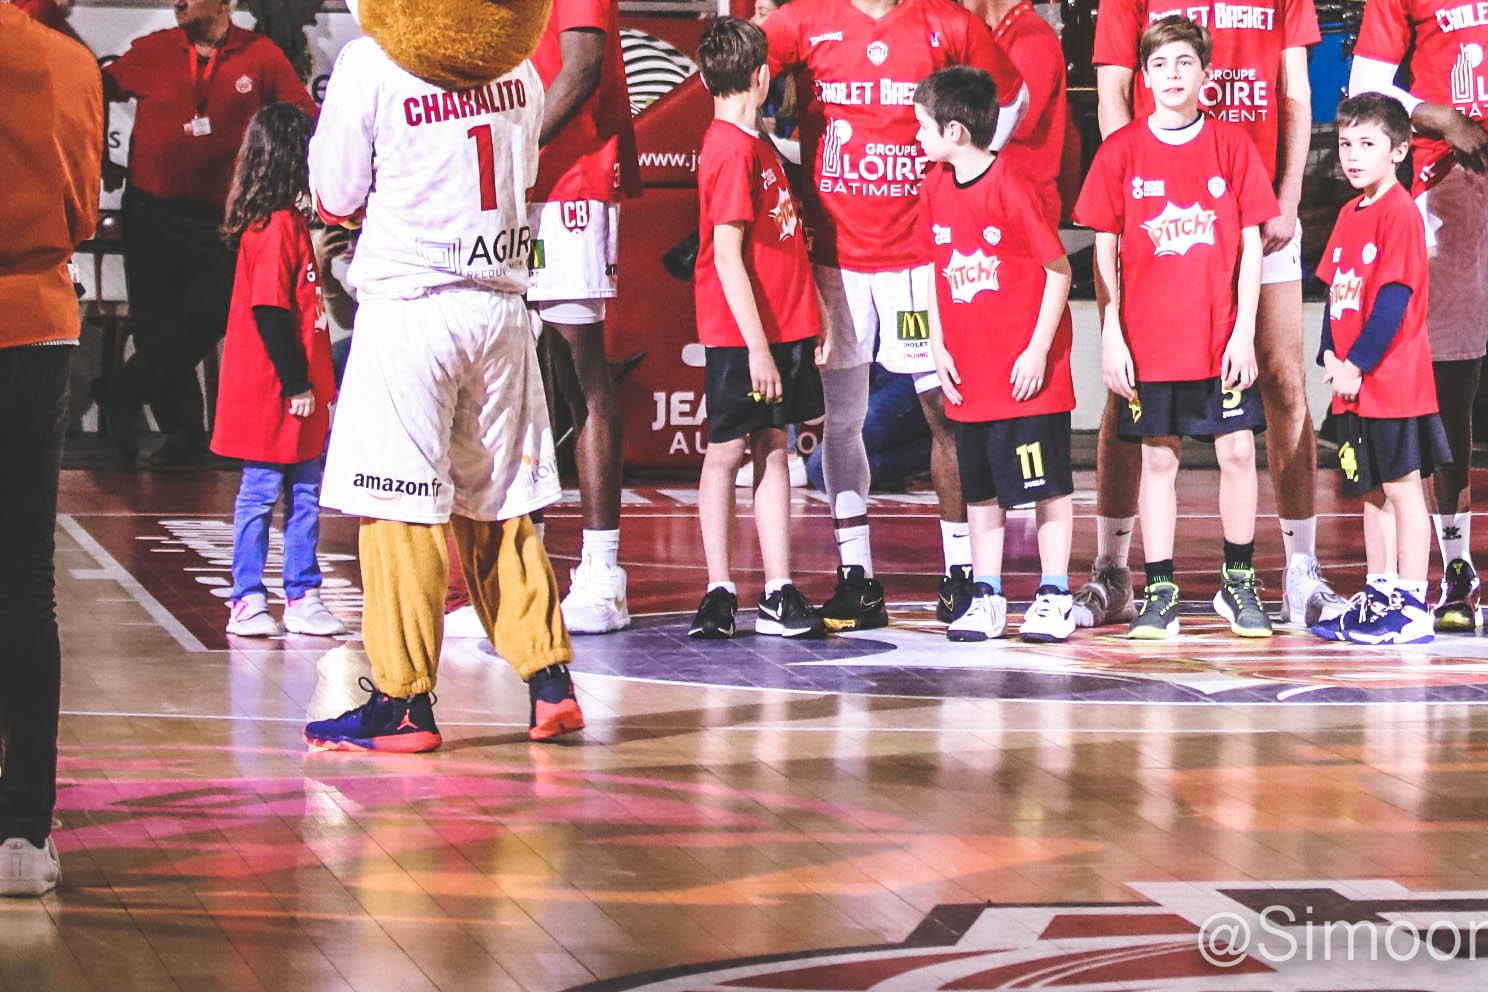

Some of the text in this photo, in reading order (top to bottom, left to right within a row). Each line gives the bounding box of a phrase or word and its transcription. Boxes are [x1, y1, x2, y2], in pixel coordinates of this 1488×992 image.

[1214, 2, 1275, 31] BASKET
[403, 78, 527, 127] CHARALITO
[1198, 81, 1268, 107] OIRE
[865, 143, 918, 156] GROUPE
[467, 123, 498, 212] 1
[843, 153, 929, 182] LOIRE
[820, 179, 922, 197] BÂTIMEN
[563, 201, 588, 228] CB
[1147, 210, 1215, 249] PITCH
[467, 225, 531, 266] AGIR
[1015, 441, 1045, 480] 11
[353, 472, 443, 498] amazon.fr
